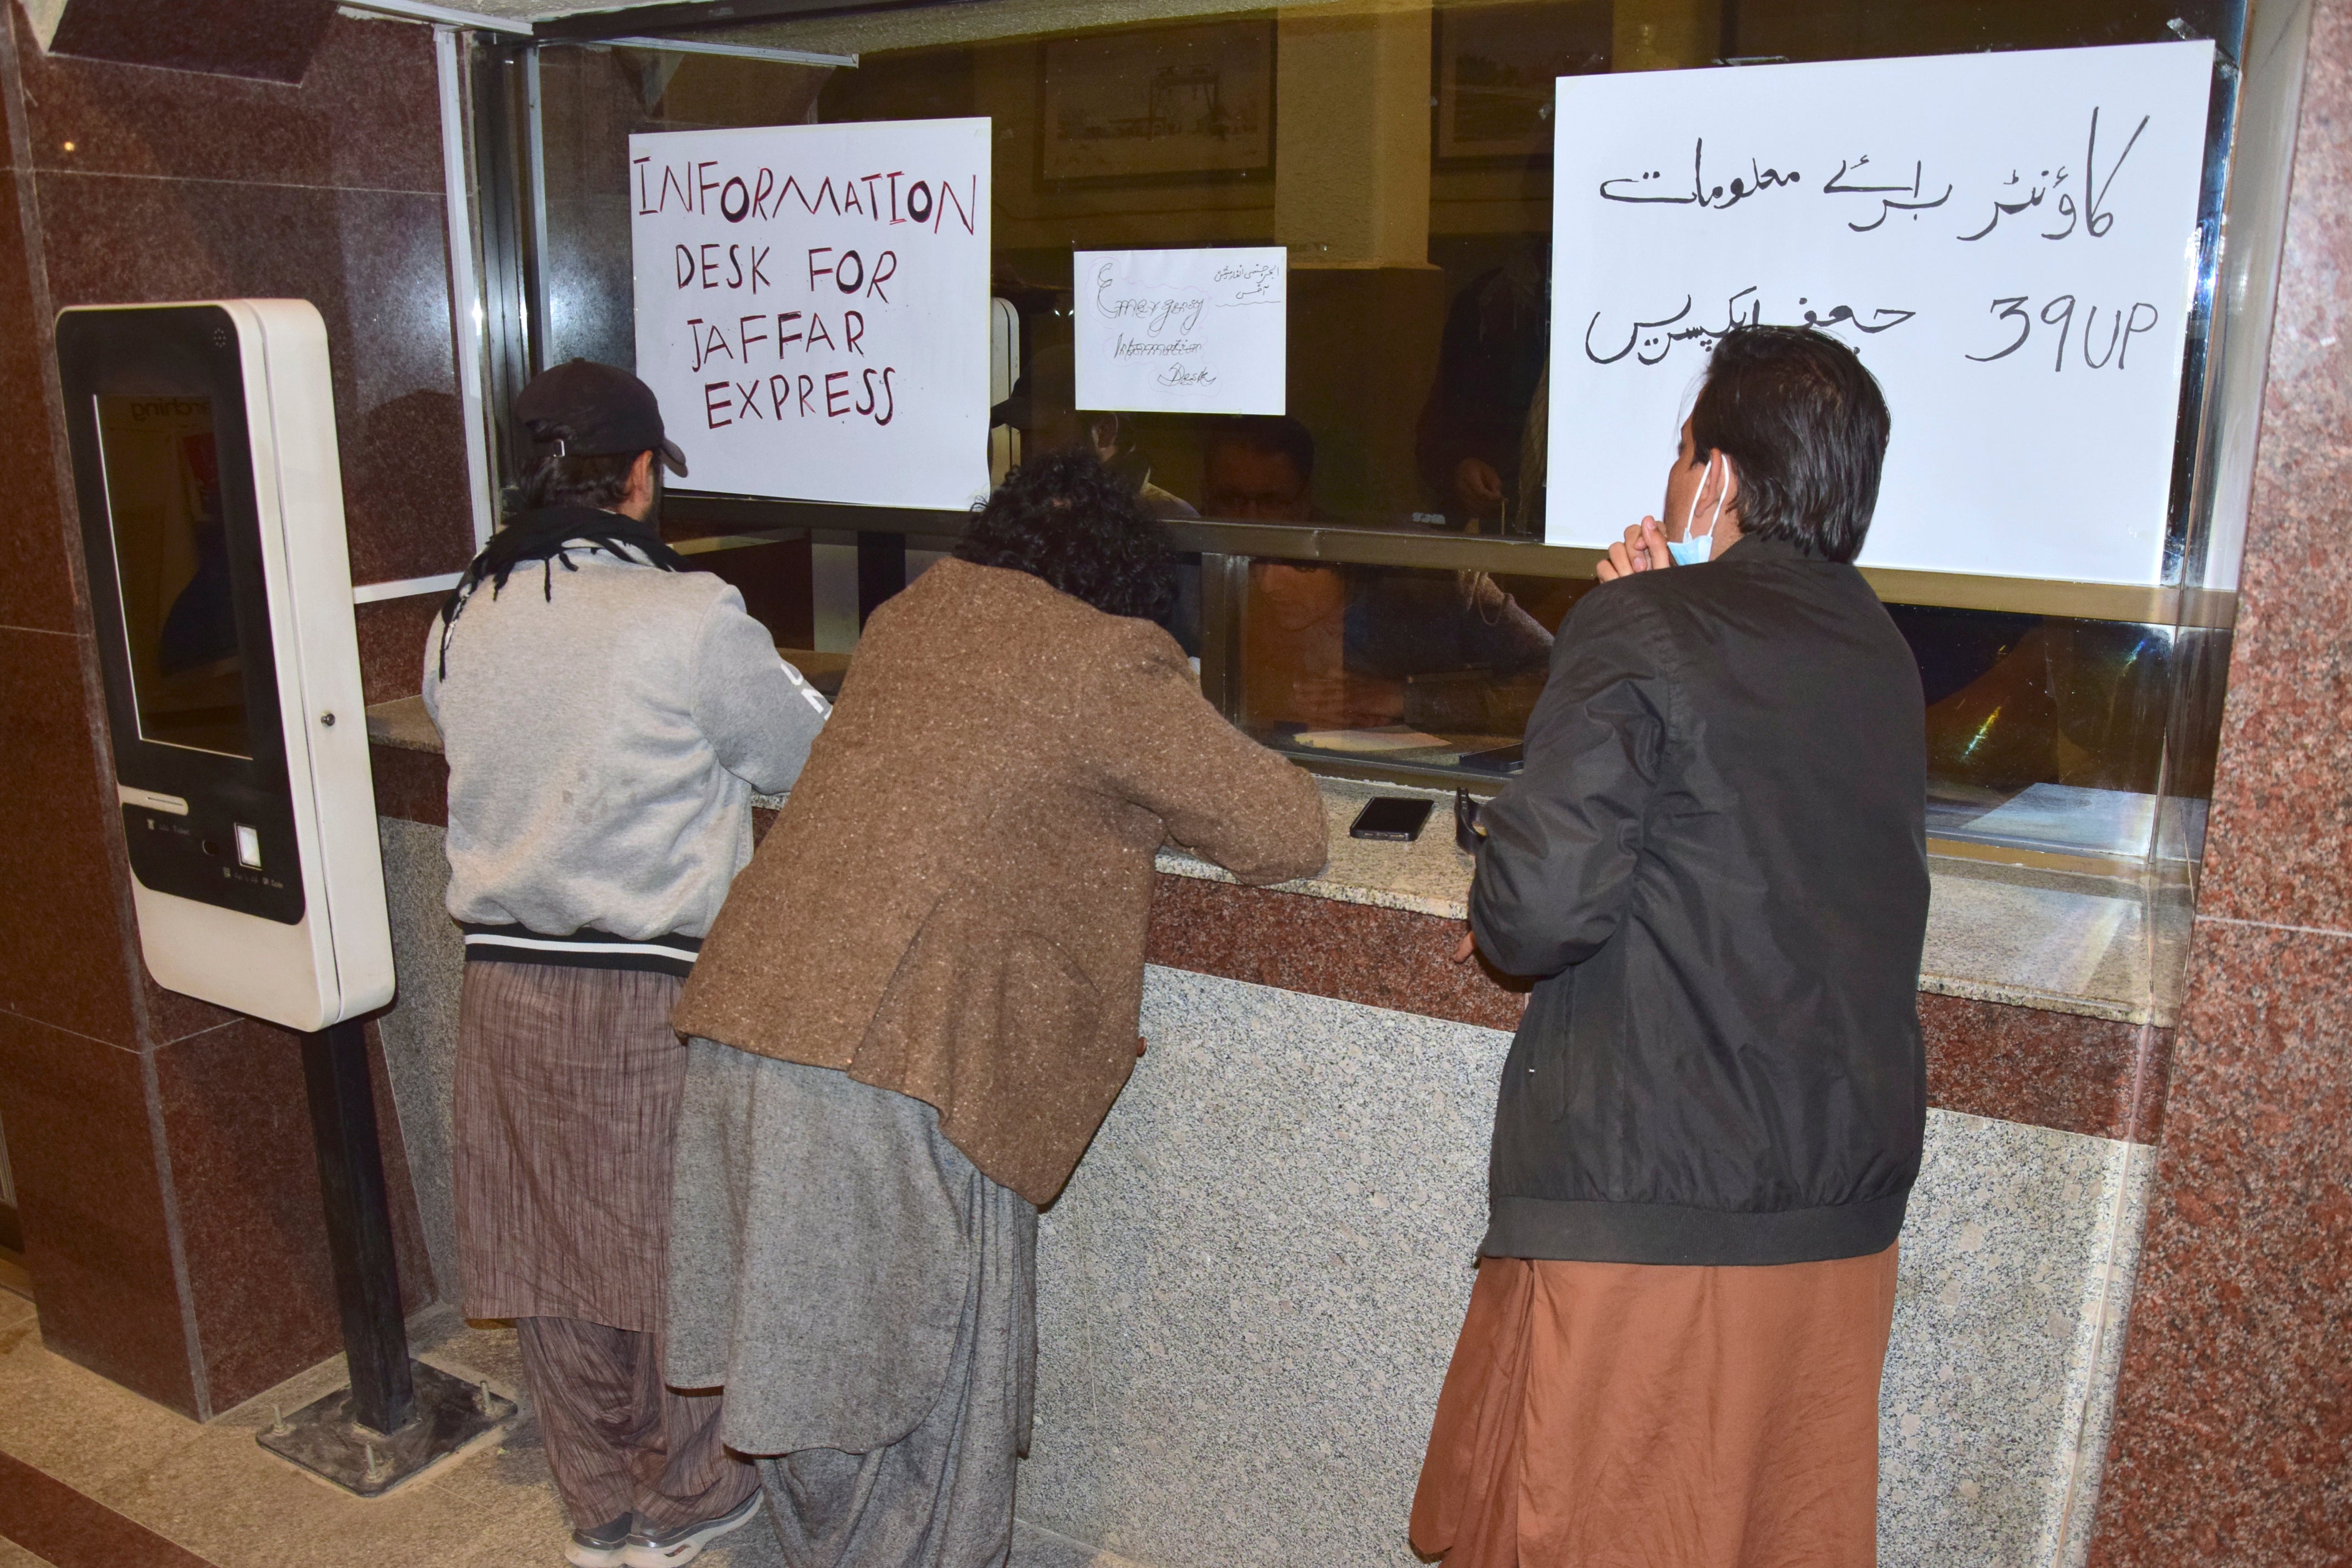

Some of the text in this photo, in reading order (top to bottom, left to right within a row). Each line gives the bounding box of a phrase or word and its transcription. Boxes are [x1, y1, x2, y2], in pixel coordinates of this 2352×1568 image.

[633, 157, 977, 234] INFORMATION
[1600, 138, 1801, 209] معلومات
[675, 244, 897, 304] DESK FOR
[1097, 263, 1204, 337] Emergency
[687, 311, 865, 372] JAFFAR
[1114, 333, 1202, 360] Information
[1796, 297, 1916, 355] جعف
[705, 367, 895, 429] EXPRESS
[1158, 362, 1217, 386] Desk
